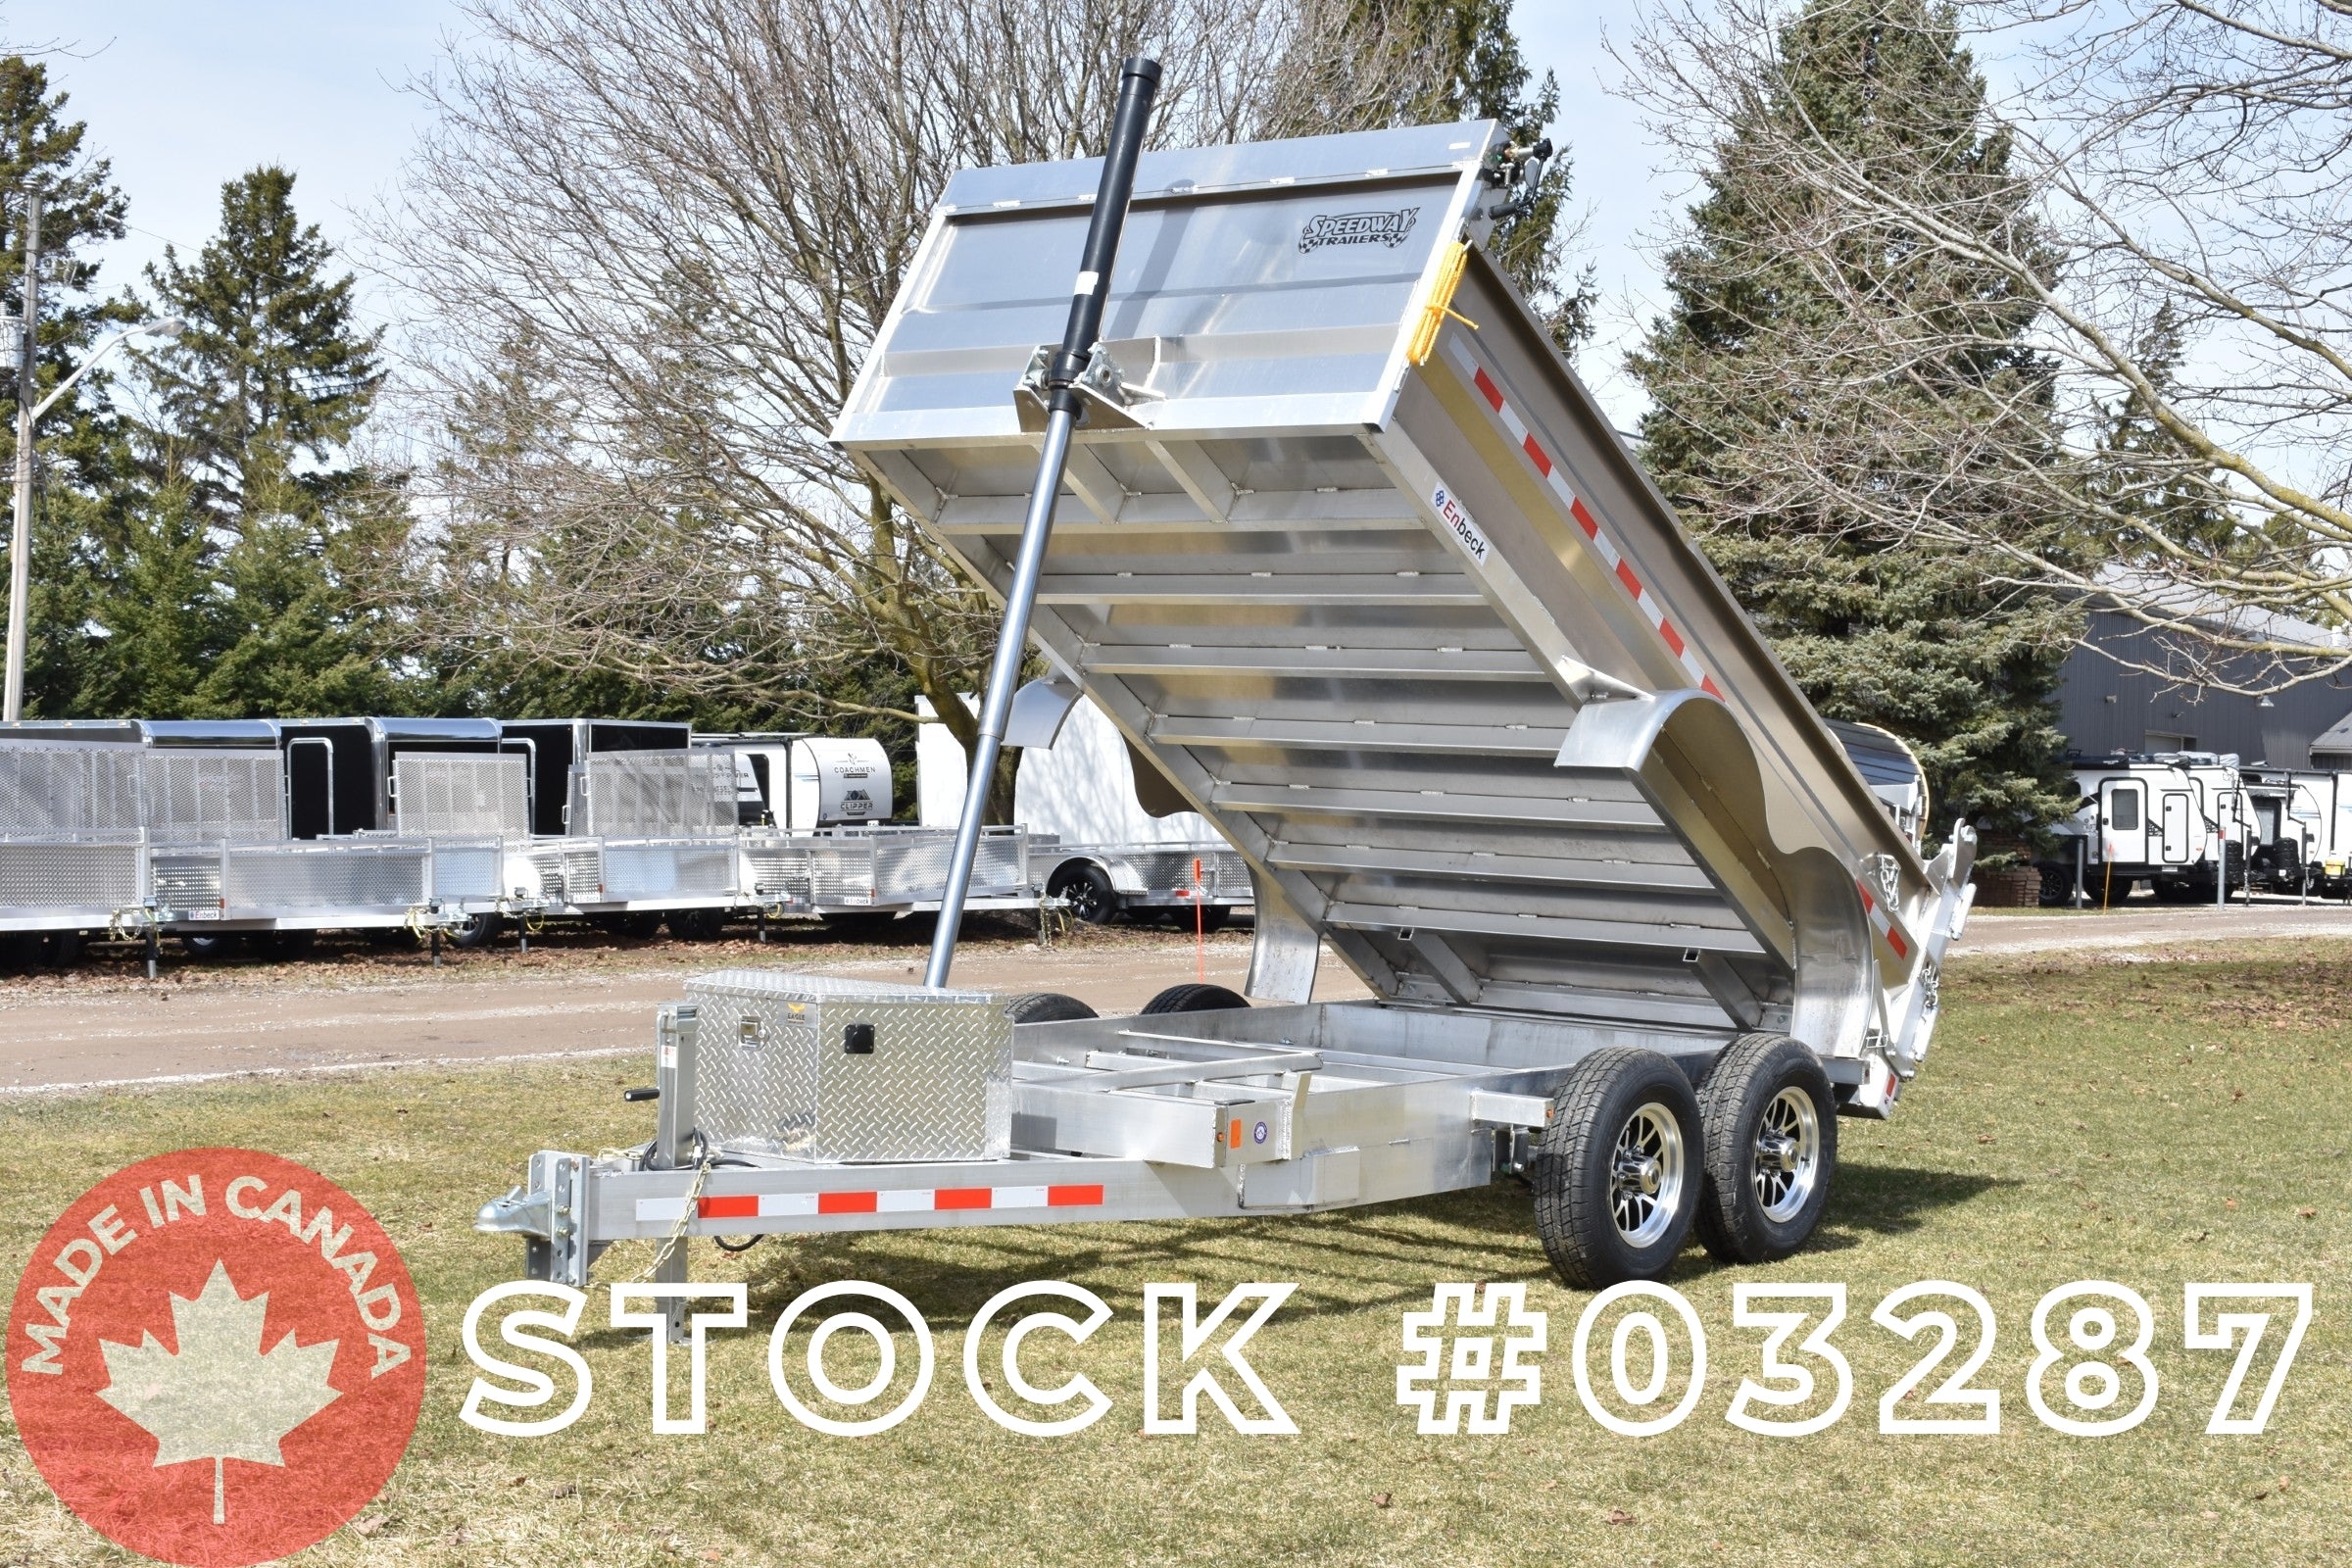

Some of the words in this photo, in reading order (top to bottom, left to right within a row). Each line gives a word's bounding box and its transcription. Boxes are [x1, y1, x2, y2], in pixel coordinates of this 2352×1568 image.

[1303, 207, 1420, 239] SPEEDWAY
[1318, 233, 1390, 246] TRAILERS
[1443, 499, 1486, 560] Enbeck
